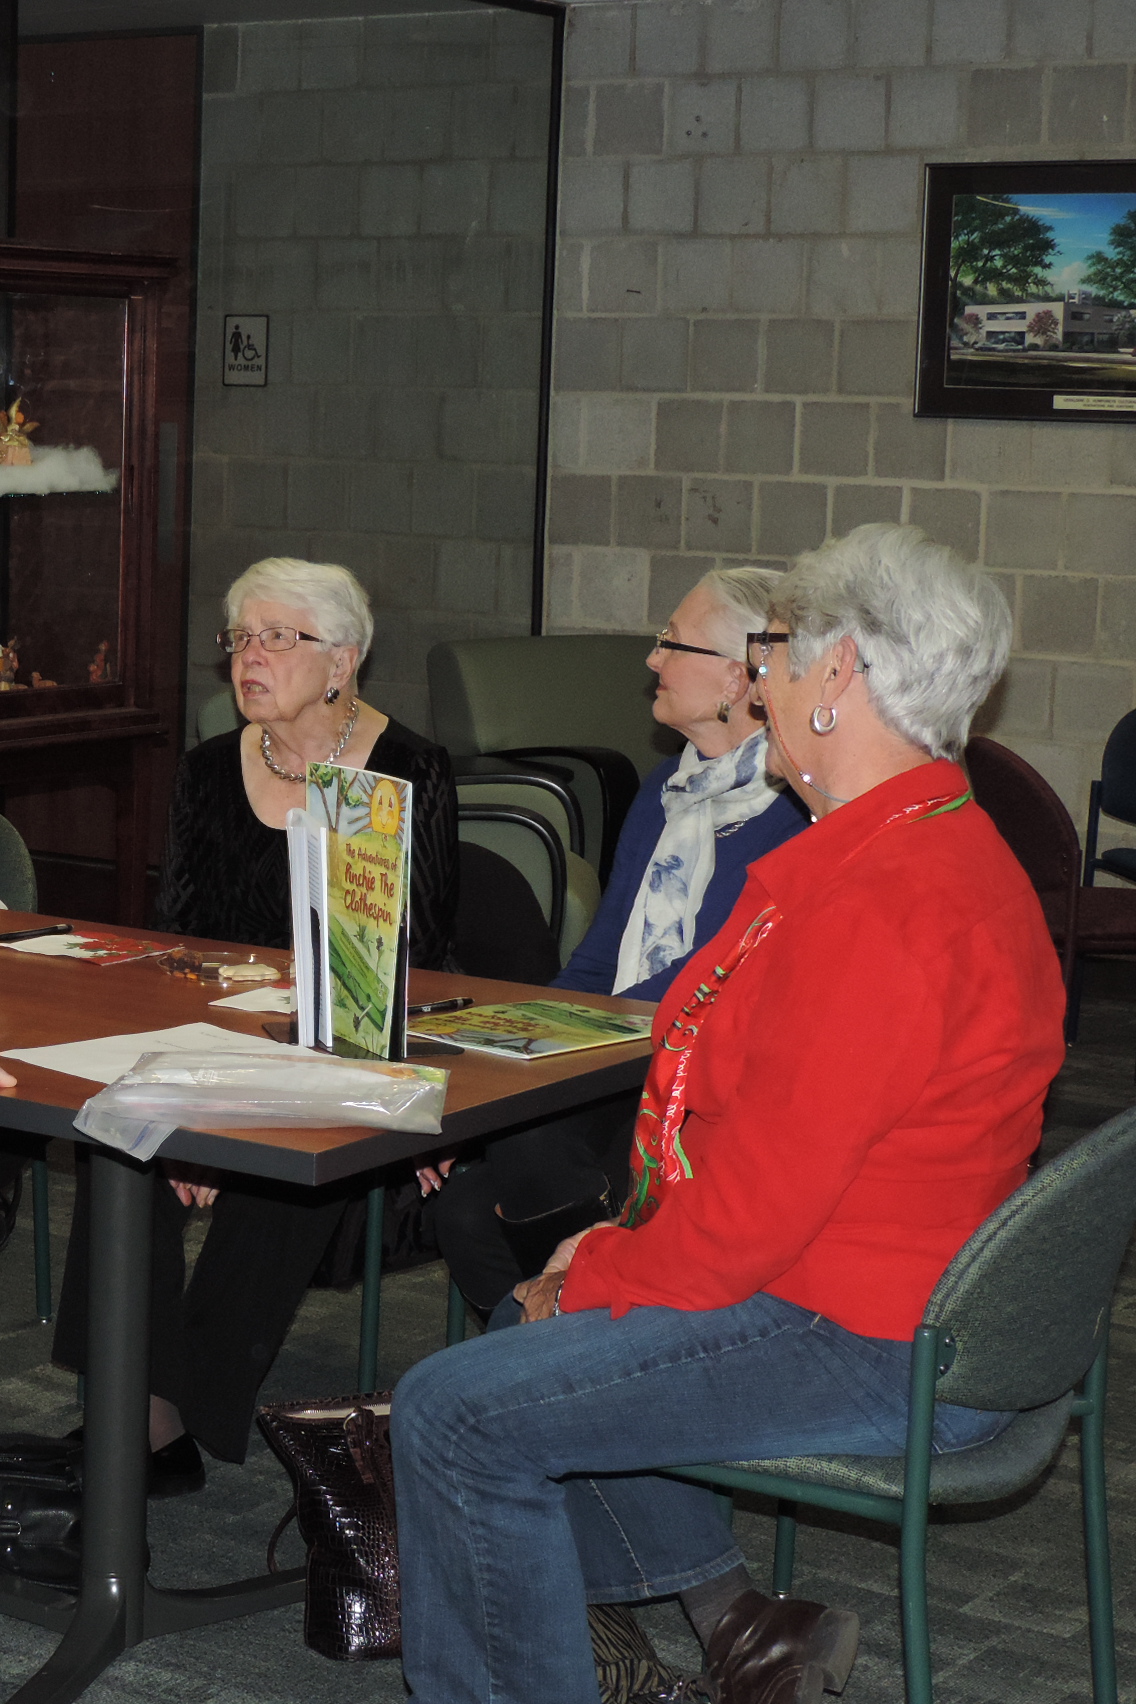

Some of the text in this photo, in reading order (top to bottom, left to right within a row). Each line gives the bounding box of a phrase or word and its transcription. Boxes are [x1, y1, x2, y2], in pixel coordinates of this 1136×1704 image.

[227, 363, 263, 372] WOMEN
[345, 843, 398, 871] The Adventures of
[344, 862, 395, 899] Pinchie The
[344, 888, 393, 928] Clothespin
